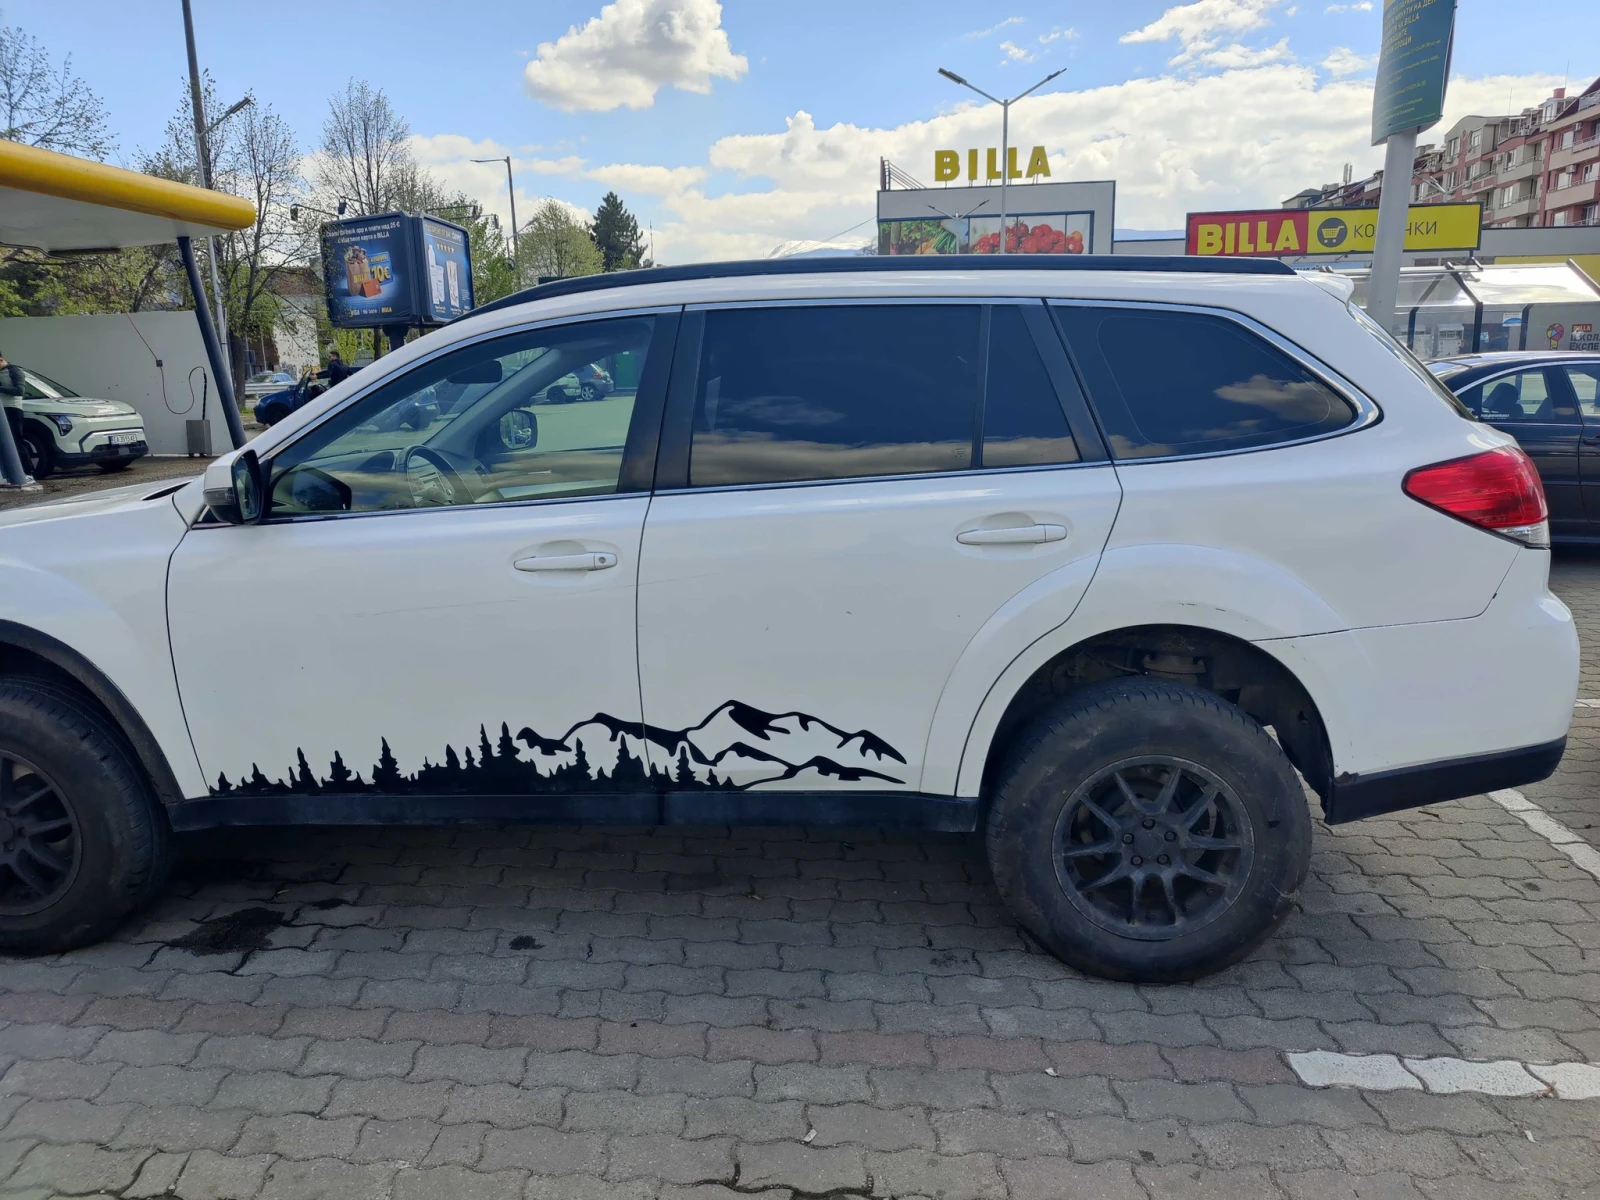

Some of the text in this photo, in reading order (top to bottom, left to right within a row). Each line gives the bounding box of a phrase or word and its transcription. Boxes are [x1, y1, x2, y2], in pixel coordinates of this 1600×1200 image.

[934, 146, 1052, 182] BILLA
[376, 231, 390, 239] BILLA
[1197, 219, 1300, 255] BILLA
[1353, 220, 1437, 239] КОЧКИ
